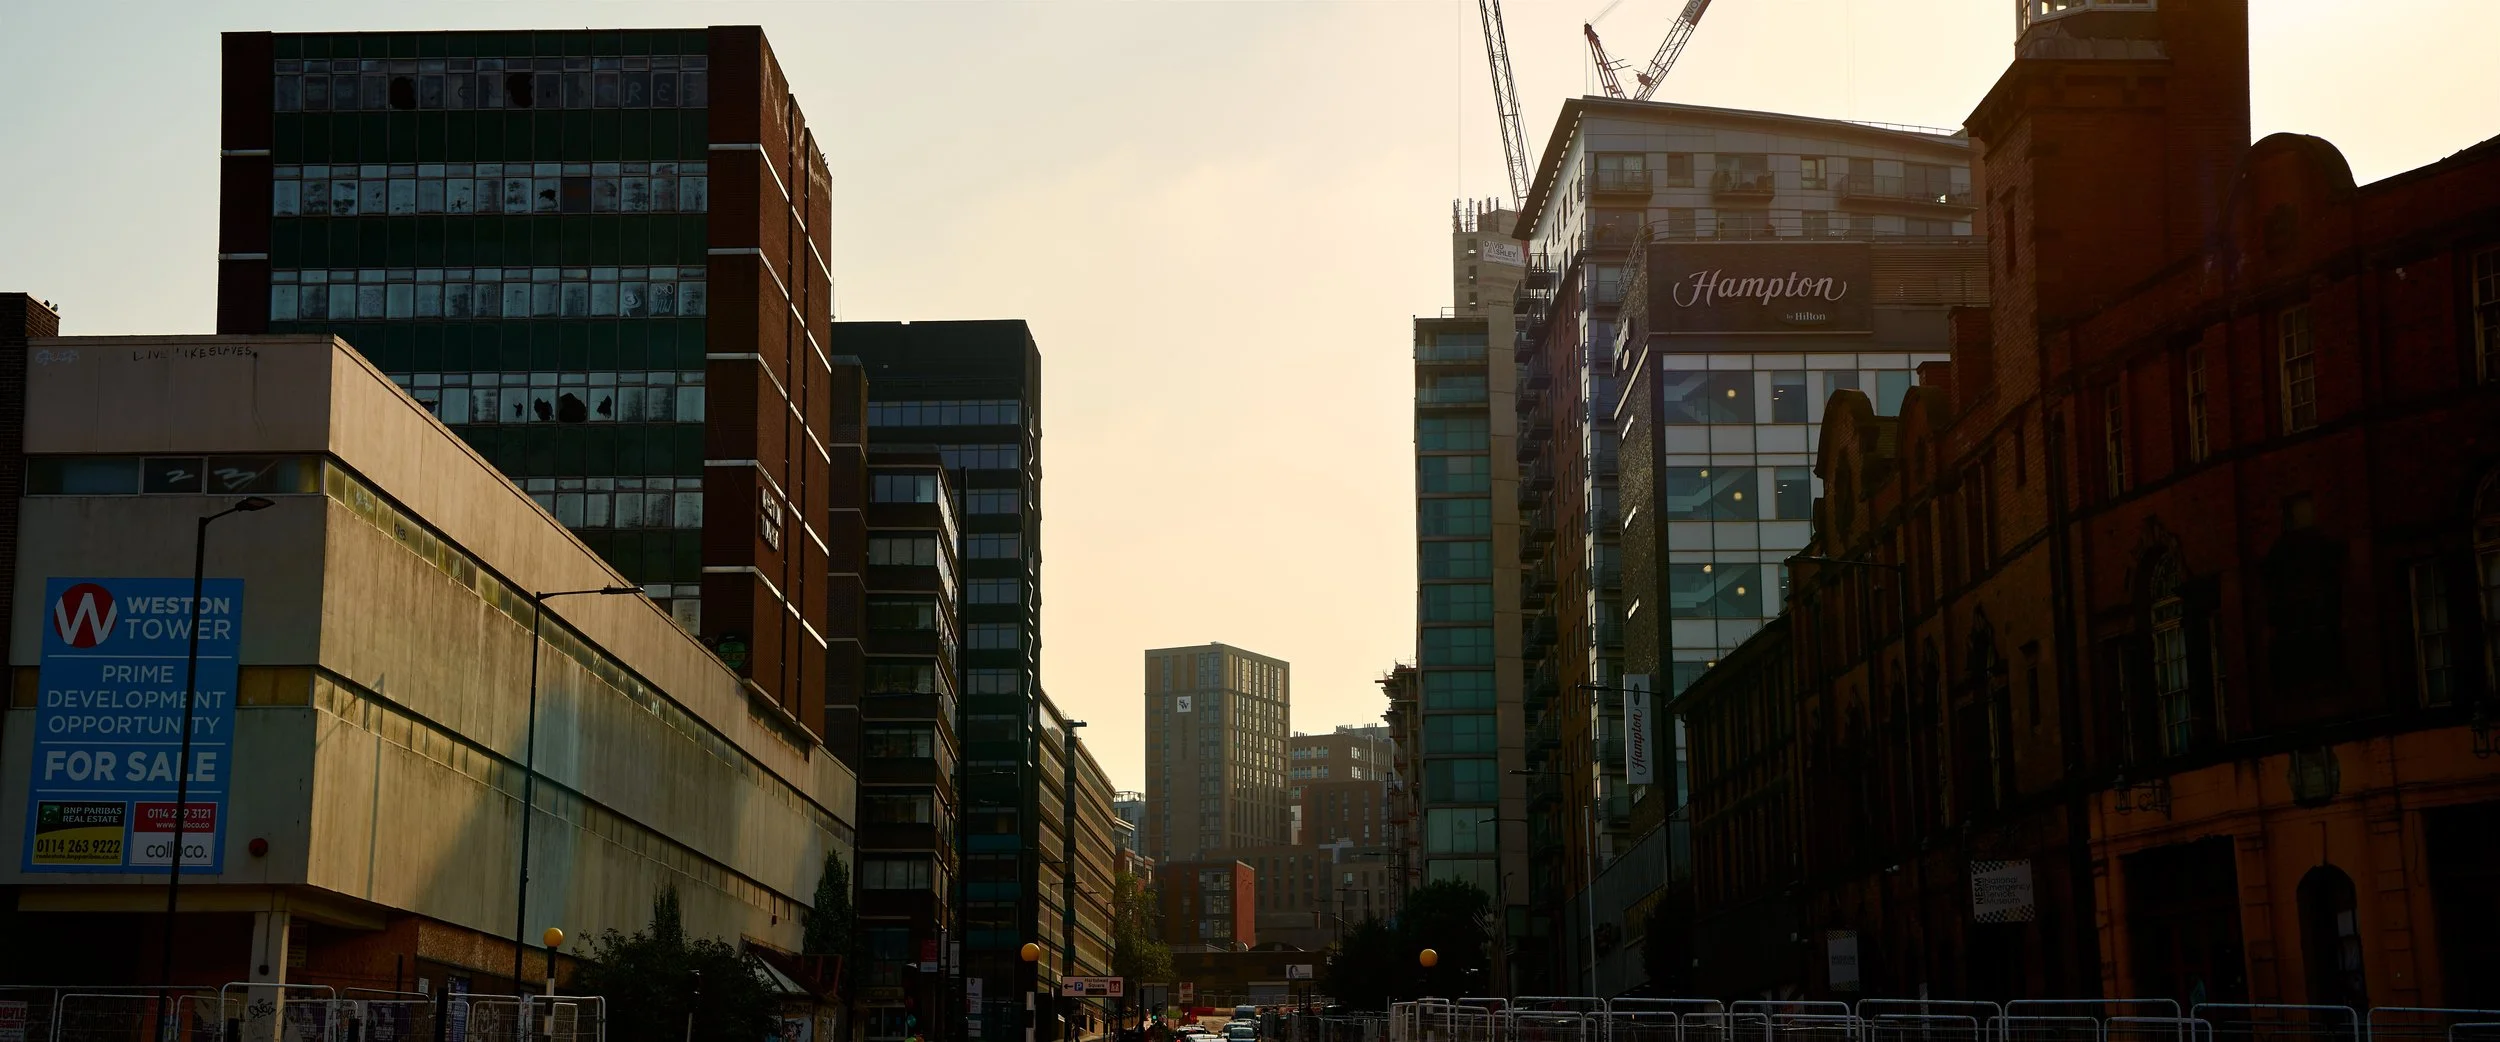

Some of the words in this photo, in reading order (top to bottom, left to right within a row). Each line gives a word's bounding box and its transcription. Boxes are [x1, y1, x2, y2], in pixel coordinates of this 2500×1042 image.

[1673, 269, 1848, 307] Hampton
[1795, 312, 1826, 321] Hilton
[126, 596, 231, 615] WESTON
[125, 618, 232, 640] TOWER
[102, 664, 175, 684] PRIME
[47, 690, 227, 709] DEVELOPMENT
[48, 715, 221, 735] OPPORTUNTY
[1632, 708, 1647, 776] Hampton
[44, 750, 117, 782] FOR
[125, 750, 217, 782] SALE
[62, 815, 86, 823] REAL
[87, 815, 119, 823] ESTATE
[63, 806, 82, 815] BNP
[84, 807, 122, 815] PARIBAS
[147, 808, 169, 819] 0114
[171, 808, 190, 819] 29
[191, 808, 211, 819] 3121
[36, 839, 64, 853] 0114
[68, 839, 89, 853] 263
[92, 839, 121, 854] 9222
[146, 841, 207, 858] collco.
[1984, 876, 2018, 884] National
[1984, 883, 2031, 892] Emergency
[1974, 878, 1984, 905] NESM
[1984, 897, 2021, 905] Museum
